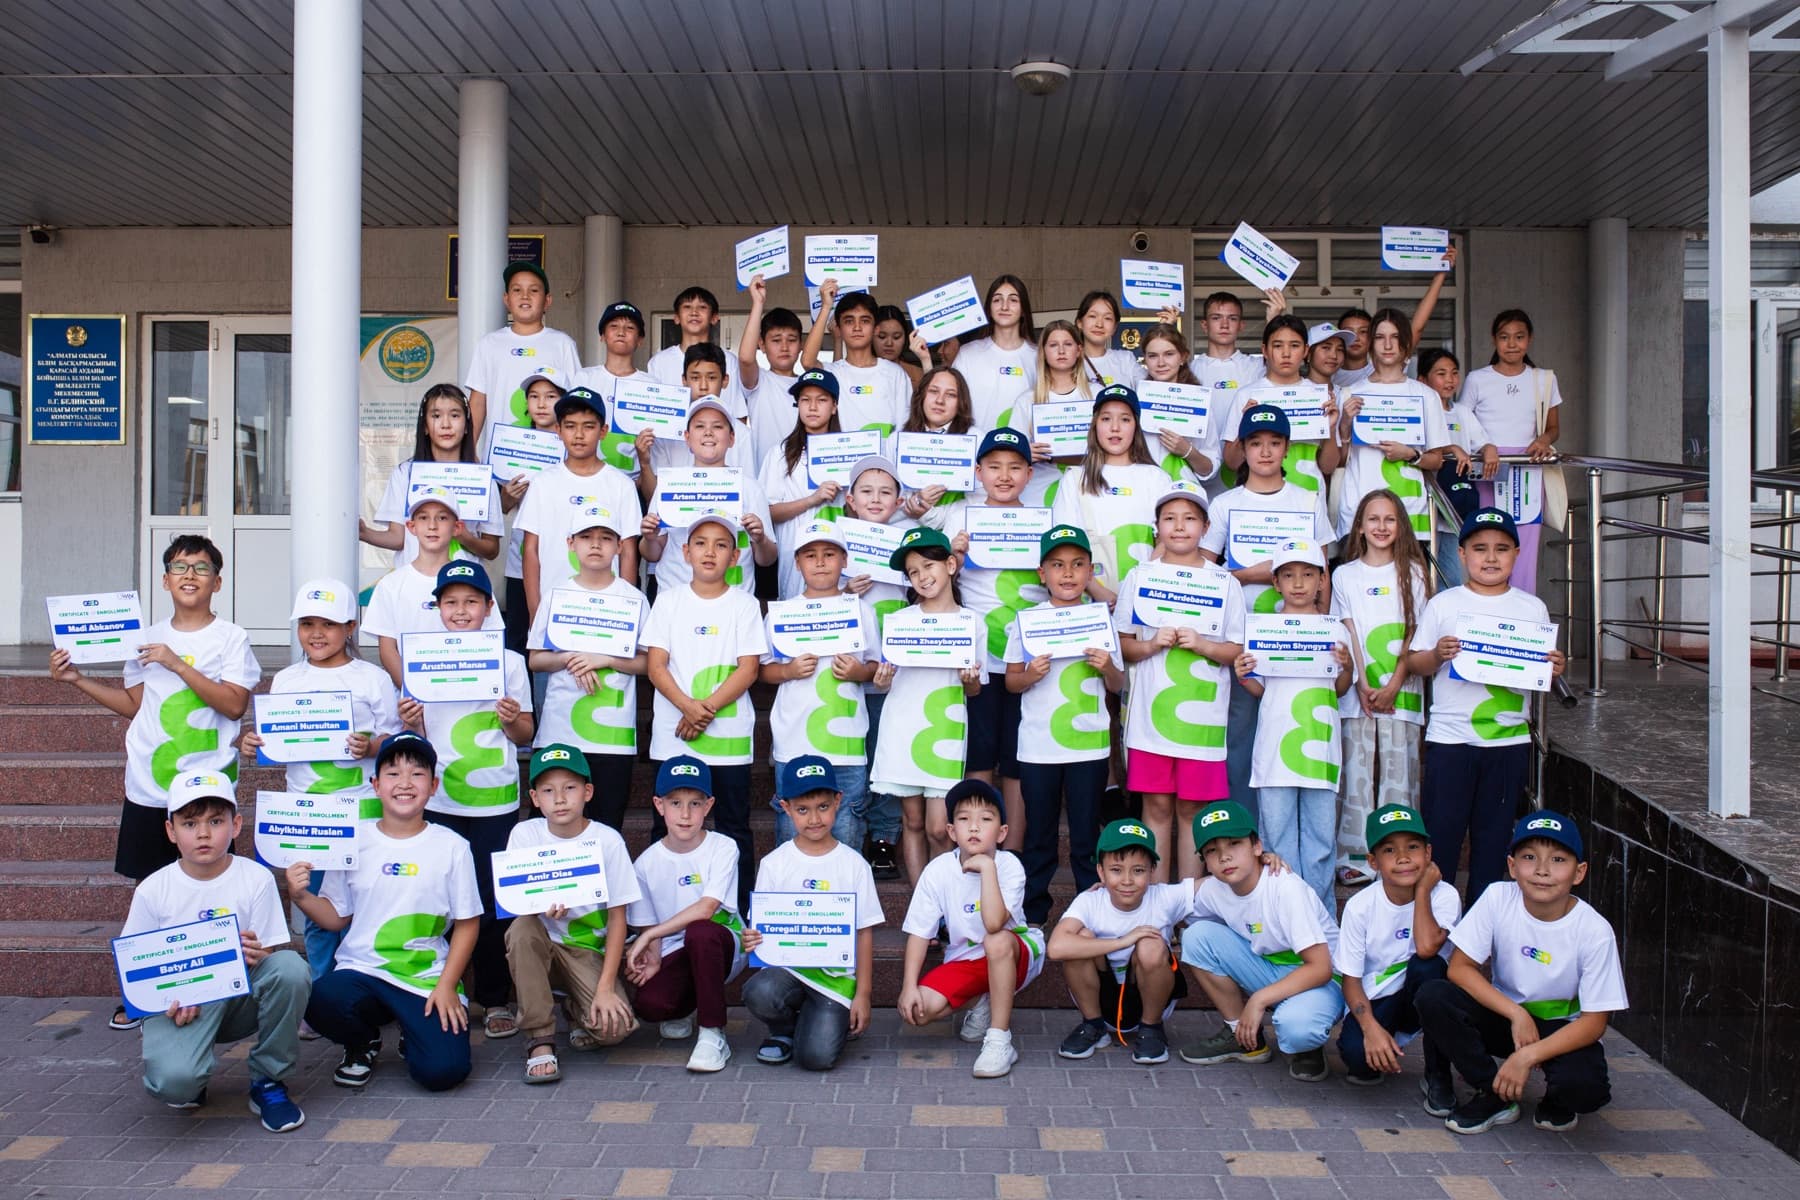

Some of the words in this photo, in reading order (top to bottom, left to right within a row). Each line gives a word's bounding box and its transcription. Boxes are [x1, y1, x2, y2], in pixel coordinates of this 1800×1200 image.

[558, 615, 577, 624] Madi
[67, 625, 87, 633] Madi
[88, 622, 125, 632] Abkanov
[1467, 629, 1501, 638] CERTIFICATE
[1510, 636, 1546, 645] ENROLLMENT
[1257, 642, 1291, 650] Nuralym
[1292, 642, 1326, 651] Shyngys
[458, 661, 487, 670] Manas
[270, 722, 298, 732] Amani
[300, 721, 340, 730] Nursultan
[541, 750, 570, 763] GSED
[671, 765, 700, 776] GSED
[796, 765, 826, 778] GSED
[267, 809, 300, 818] CERTIFICATE
[1201, 810, 1230, 828] GSED
[1379, 811, 1411, 824] GSED
[268, 825, 309, 836] Abylkhair
[311, 827, 344, 836] Ruslan
[1527, 818, 1562, 831] GSED
[1119, 824, 1147, 839] GSED
[382, 863, 419, 876] GSED
[526, 872, 550, 883] Amir
[551, 870, 573, 880] Dias
[803, 879, 830, 891] GSED
[764, 925, 800, 935] Toregali
[801, 925, 842, 935] Bakytbek
[132, 949, 174, 962] CERTIFICATE
[183, 936, 227, 951] ENROLLMENT
[1520, 946, 1552, 965] GSED
[159, 962, 188, 976] Batyr
[190, 957, 204, 968] Ali
